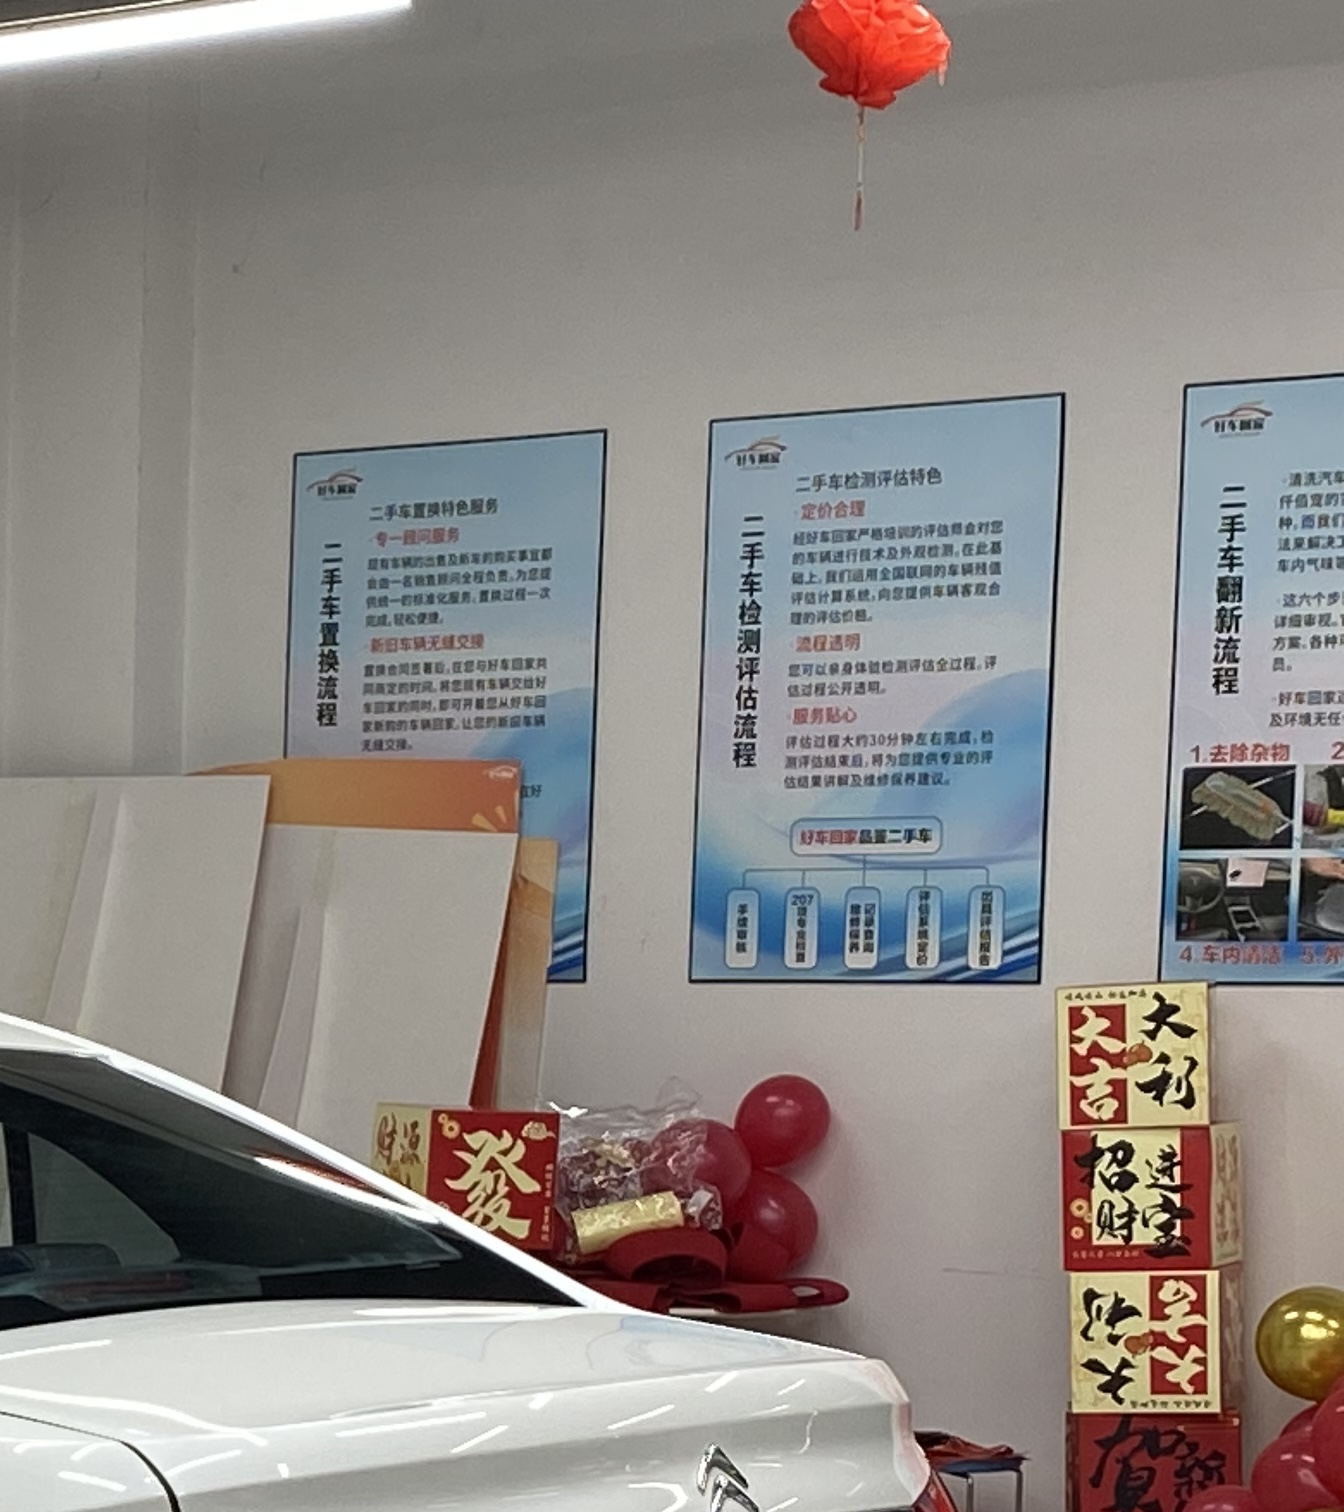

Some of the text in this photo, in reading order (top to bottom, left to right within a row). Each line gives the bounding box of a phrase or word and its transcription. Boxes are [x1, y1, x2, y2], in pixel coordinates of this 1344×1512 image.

[316, 542, 343, 727] 二手车置换流程
[733, 515, 766, 768] 二手车检测评估流程
[1211, 485, 1247, 695] 二手车翻新流程
[792, 706, 857, 725] 服务贴心
[1269, 711, 1344, 727] 及环境无任
[791, 894, 814, 906] 207
[1069, 1006, 1128, 1121] 大吉
[1135, 991, 1198, 1111] 大利
[1073, 1133, 1140, 1246] 招财
